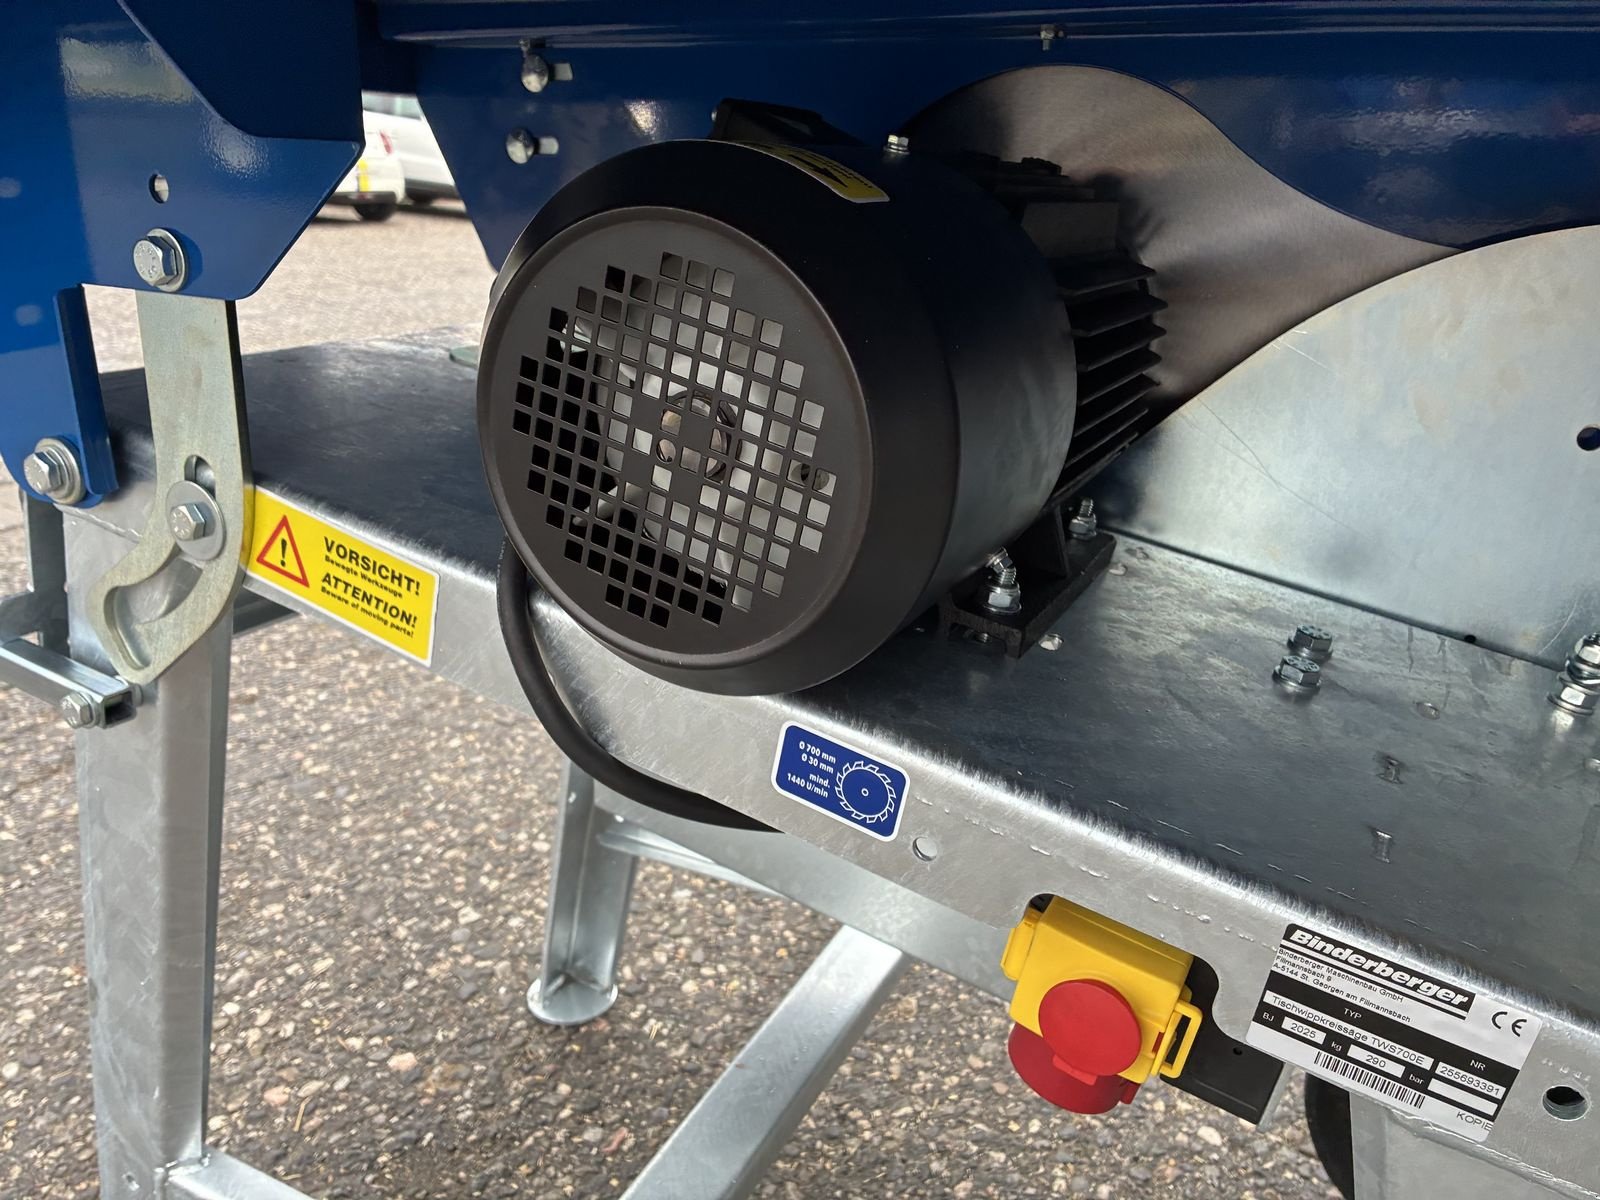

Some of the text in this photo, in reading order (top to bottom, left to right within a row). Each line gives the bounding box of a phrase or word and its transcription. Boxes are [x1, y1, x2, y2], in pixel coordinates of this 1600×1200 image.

[324, 536, 420, 596] VORSICHT!
[325, 555, 403, 598] Bewegte Werkzeuge
[322, 572, 417, 628] ATTENTION!
[321, 586, 349, 605] Beware
[361, 607, 388, 626] moving
[390, 622, 414, 638] parts!
[807, 744, 820, 757] 700
[822, 752, 836, 764] mm
[808, 755, 819, 766] 30
[819, 762, 834, 774] mm
[787, 773, 828, 798] 1440 U/min
[809, 773, 831, 788] mind.
[1276, 956, 1328, 979] Fillmannsbach
[1278, 948, 1404, 1003] Binderberger Maschinenbau GmbH
[1290, 929, 1469, 1006] Binderberger
[1273, 963, 1411, 1023] A-5144 St. Georgen am Fillmannsbach
[1262, 1012, 1274, 1022] BJ
[1344, 1007, 1362, 1019] TYP
[1290, 1022, 1316, 1039] 2025
[1331, 1041, 1342, 1052] kg
[1371, 1037, 1425, 1065] TWS700E
[1366, 1055, 1386, 1068] 290
[1470, 1059, 1486, 1071] NR
[1409, 1073, 1425, 1085] bar
[1439, 1066, 1501, 1096] 255693391
